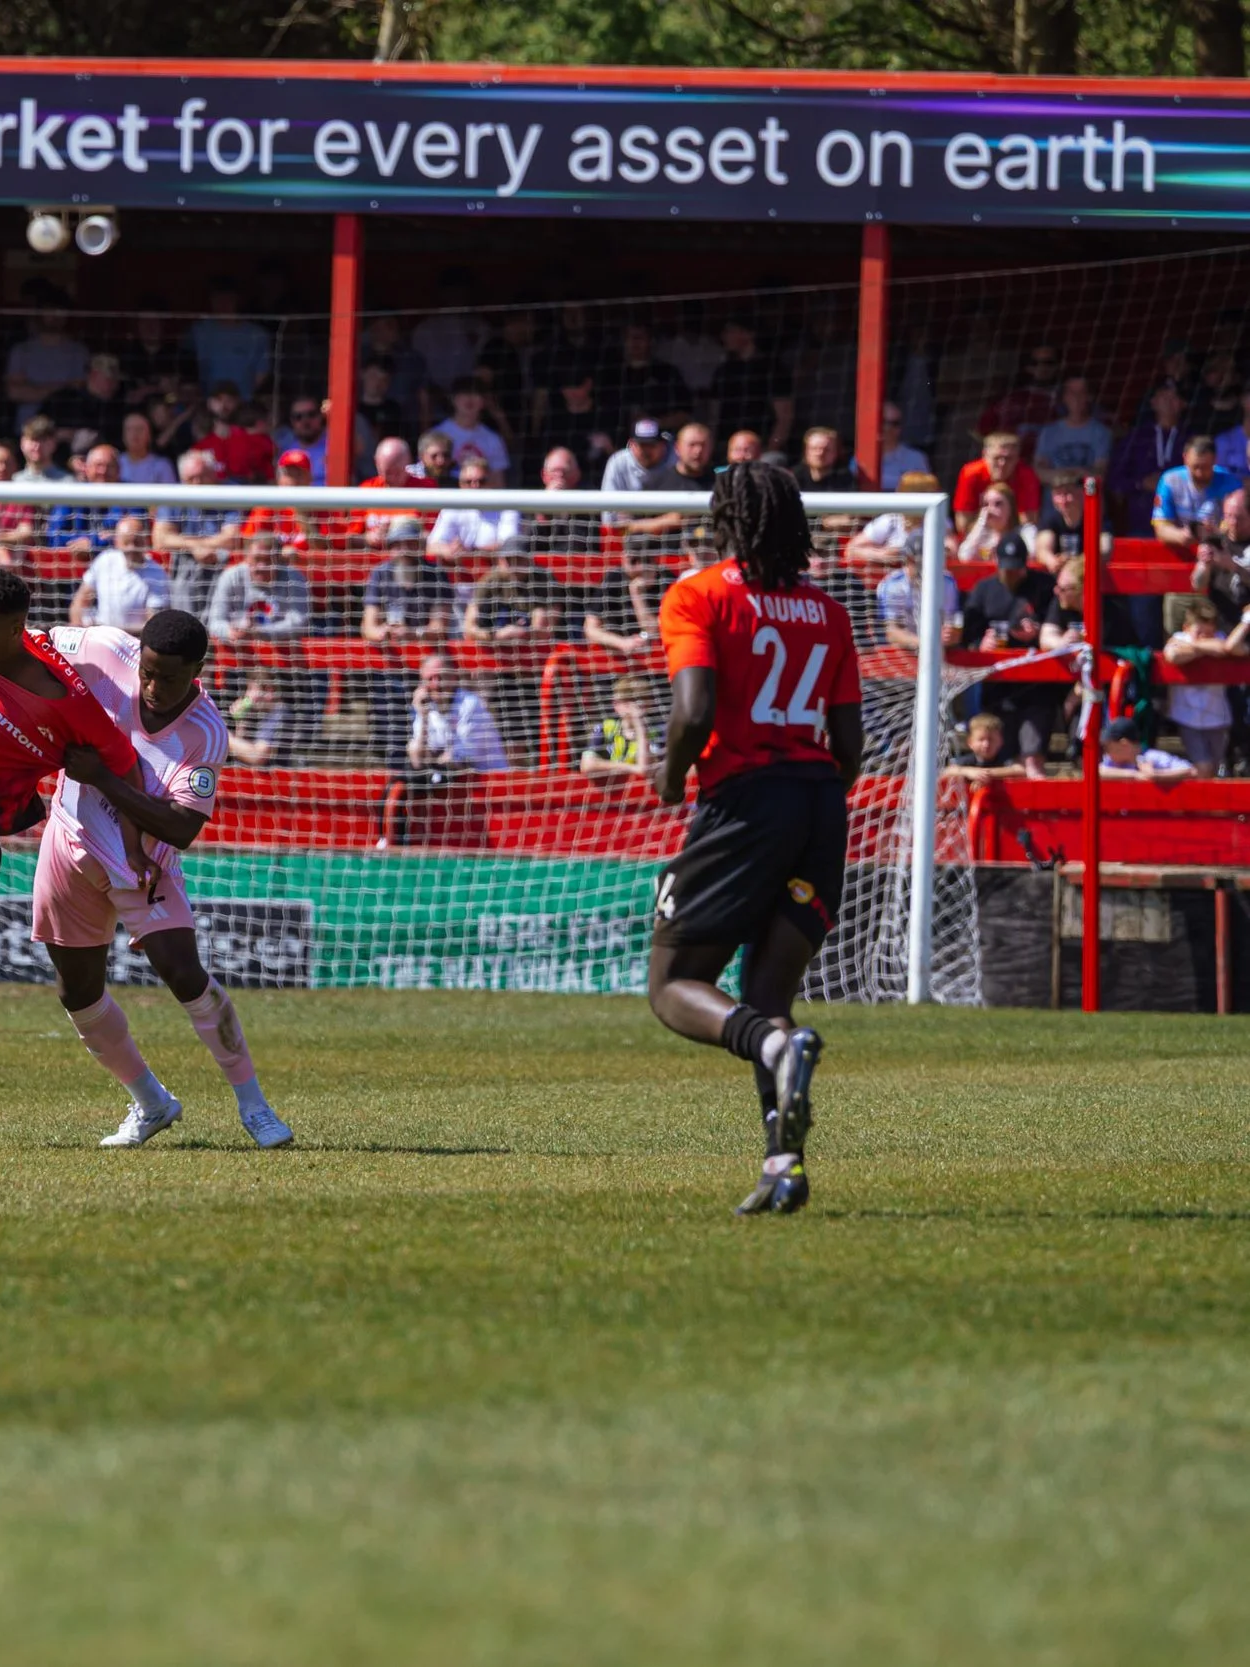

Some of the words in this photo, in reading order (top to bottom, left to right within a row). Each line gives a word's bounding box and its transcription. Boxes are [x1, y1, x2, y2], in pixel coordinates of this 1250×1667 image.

[174, 99, 289, 174] for
[314, 120, 541, 197] every
[568, 117, 788, 185] asset
[816, 130, 912, 187] on
[944, 120, 1155, 192] earth
[746, 594, 827, 625] YOUMBI
[751, 625, 829, 744] 24
